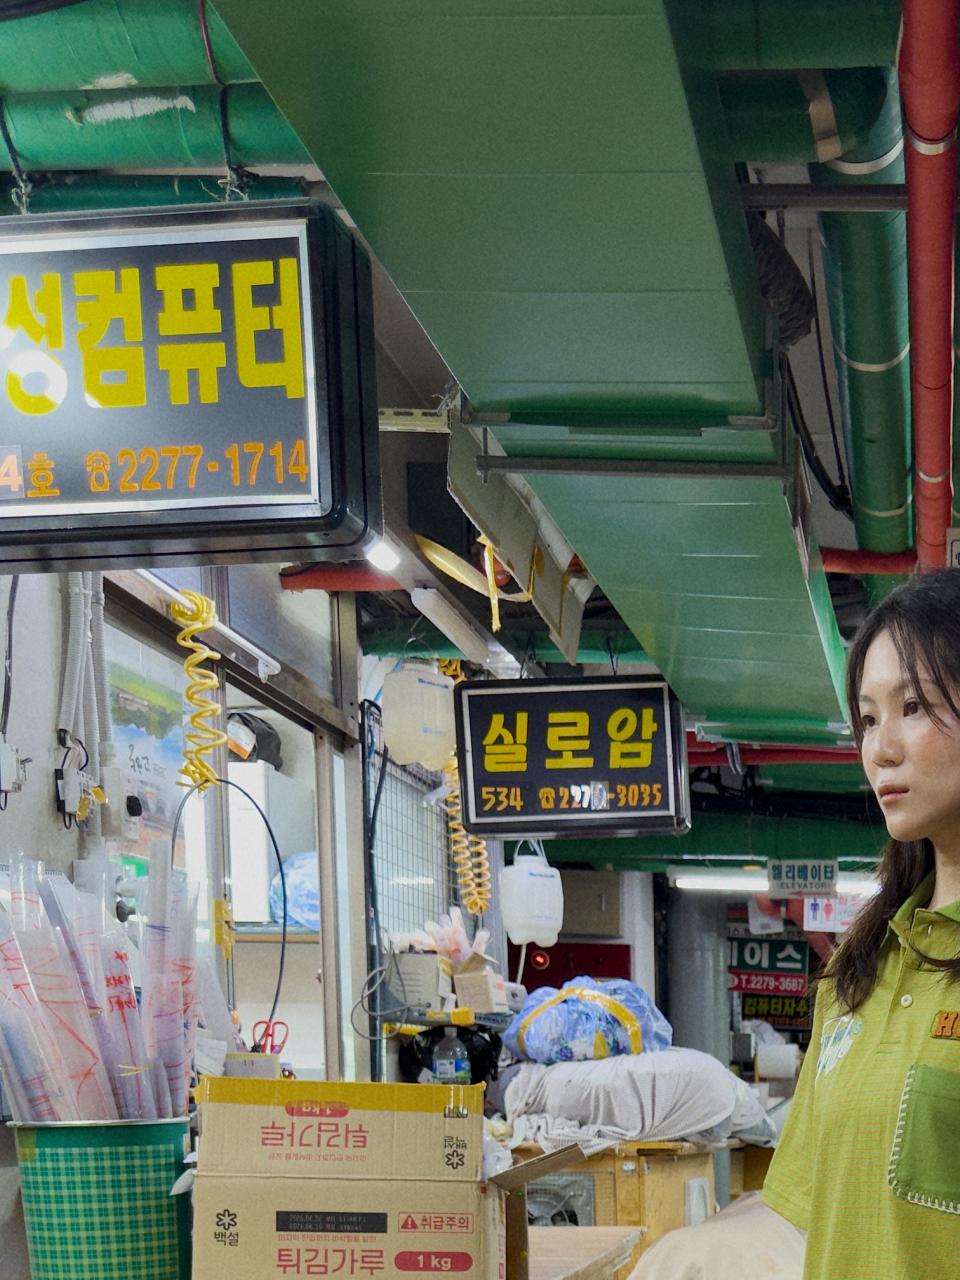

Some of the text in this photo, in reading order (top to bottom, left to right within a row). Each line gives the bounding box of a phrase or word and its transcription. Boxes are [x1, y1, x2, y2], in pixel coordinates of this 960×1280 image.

[116, 440, 309, 493] 2277-1714
[481, 707, 658, 773] 실로암
[481, 786, 524, 812] 534
[419, 1215, 471, 1231] 취급주의
[275, 1247, 386, 1276] 튀김가루
